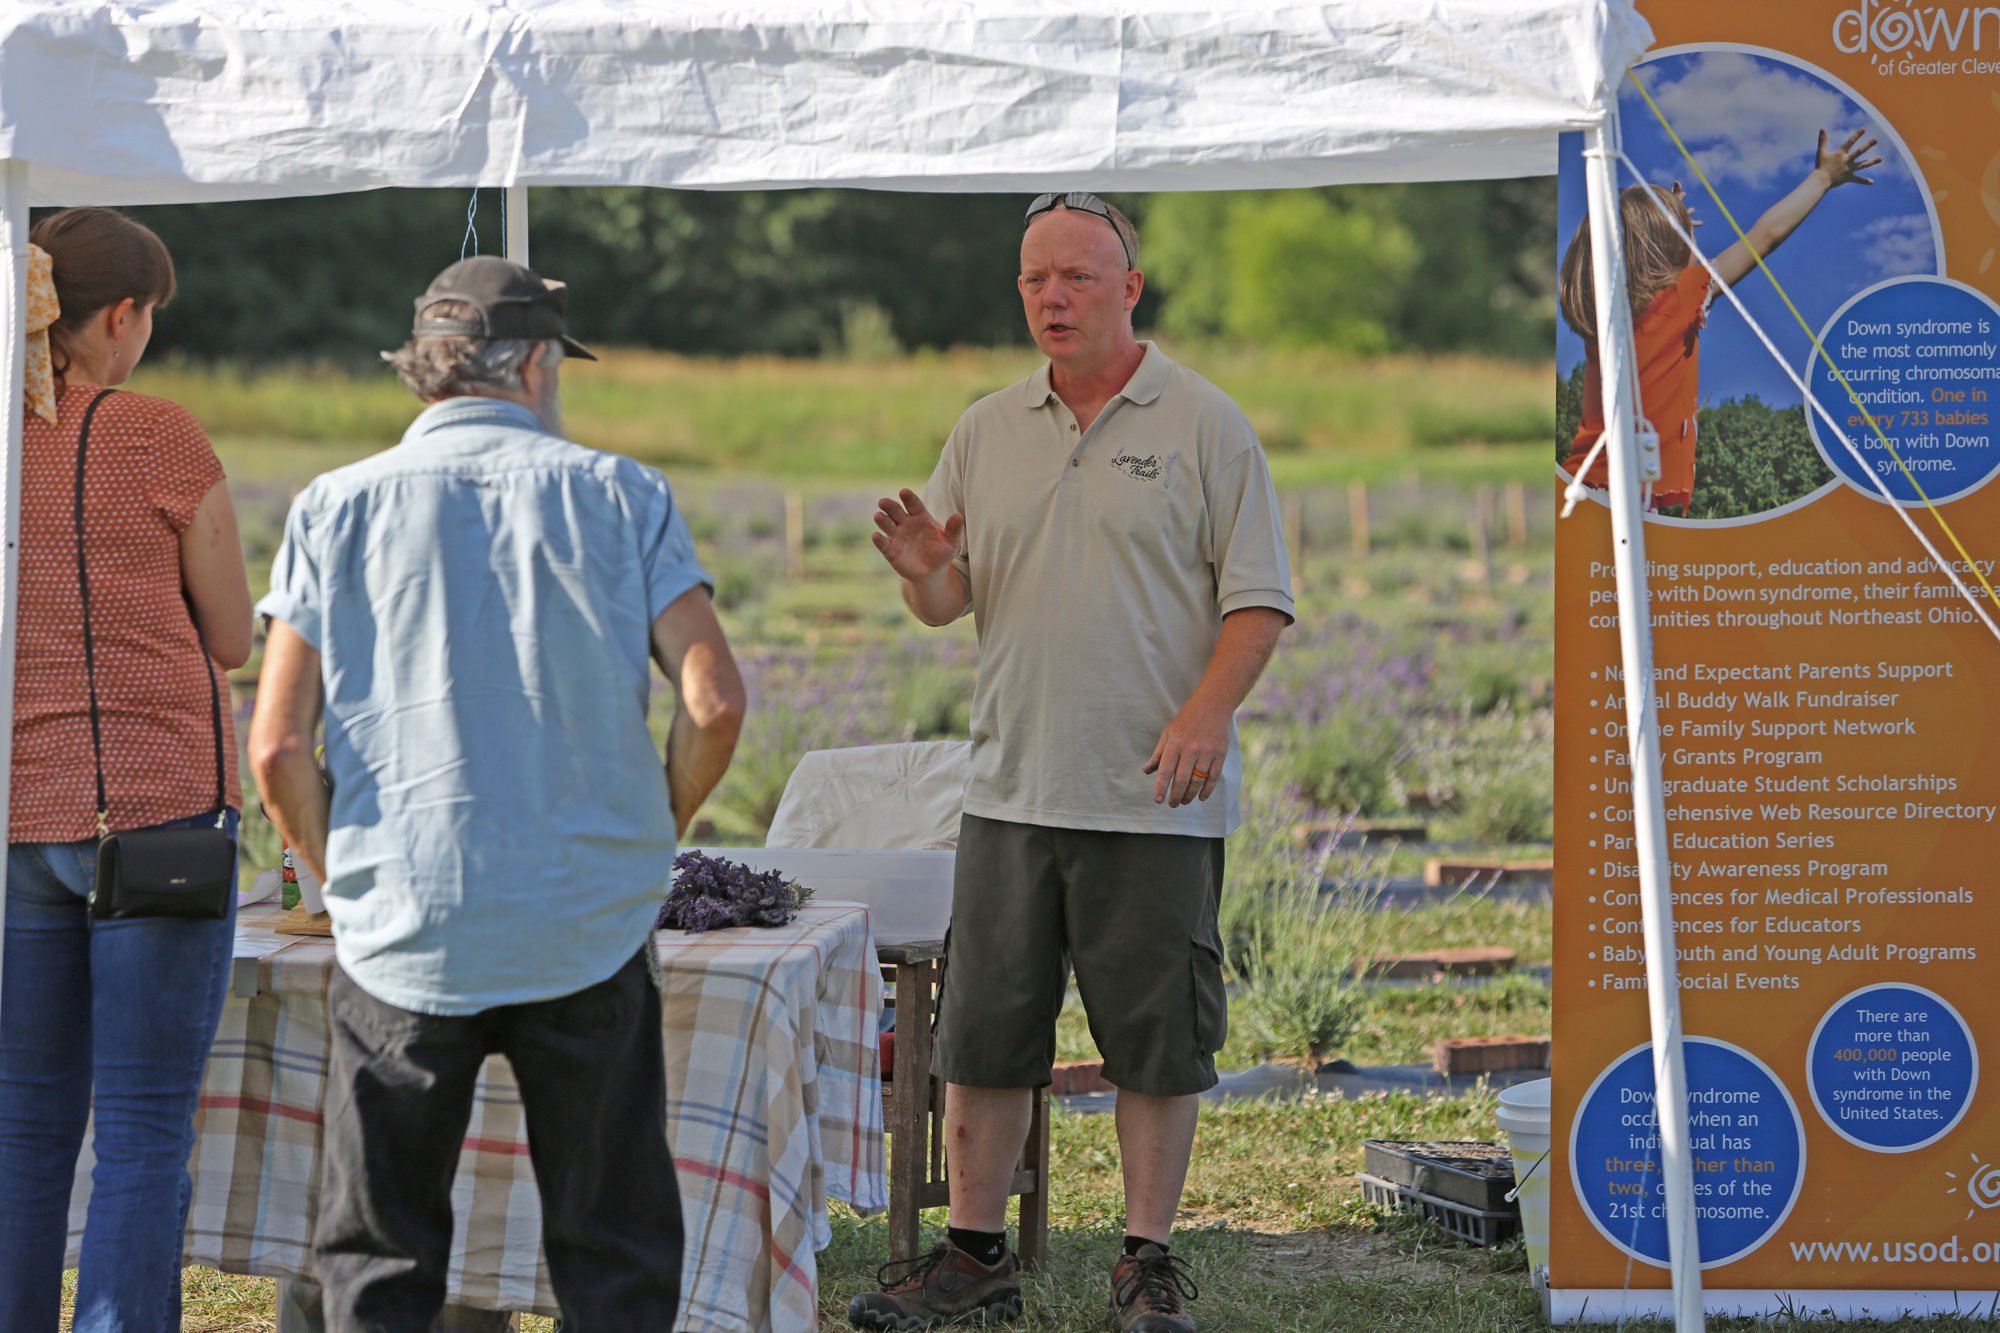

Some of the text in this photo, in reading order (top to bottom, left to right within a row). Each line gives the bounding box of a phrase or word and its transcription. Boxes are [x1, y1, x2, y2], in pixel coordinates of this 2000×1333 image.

[1832, 0, 2000, 53] down
[1879, 60, 1894, 75] of
[1898, 60, 1957, 75] Greater
[1848, 319, 1990, 338] Down syndrome is
[1841, 341, 1996, 359] the most commonly
[1849, 388, 1986, 404] condition. One in
[1848, 410, 1988, 430] every 733 babies
[1905, 433, 1938, 448] with
[1946, 433, 1988, 447] Down
[1111, 455, 1157, 468] Lavender
[1877, 457, 1956, 475] syndrome.
[1130, 465, 1159, 479] Trails
[1684, 561, 1762, 580] support,
[1769, 559, 1862, 575] education
[1868, 558, 1901, 574] and
[1657, 585, 1698, 601] with
[1704, 585, 1755, 601] Down
[1760, 584, 1858, 604] syndrome,
[1864, 583, 1910, 599] their
[1589, 607, 1979, 630] counities throughout Northeast Ohio.
[1653, 664, 1688, 680] and
[1695, 664, 1792, 684] Expectant
[1799, 663, 1871, 679] Parents
[1878, 662, 1953, 682] Support
[1604, 691, 1899, 712] Anal Buddy Walk Fundraiser
[1682, 720, 1744, 740] Family
[1752, 720, 1826, 740] Support
[1834, 718, 1915, 735] Network
[1674, 749, 1736, 764] Grants
[1744, 749, 1822, 768] Program
[1604, 774, 1957, 797] Ungraduate Student Scholarships
[1603, 803, 1996, 823] Coehensive Web Resource Directory
[1674, 833, 1768, 849] Education
[1777, 832, 1834, 848] Series
[1603, 860, 1887, 882] Disaity Awareness Program
[1603, 887, 1973, 908] Conences for Medical Professionals
[1730, 917, 1758, 933] for
[1766, 917, 1861, 932] Educators
[1675, 945, 1716, 963] outh
[1723, 945, 1757, 961] and
[1764, 945, 1821, 964] Young
[1827, 944, 1879, 960] Adult
[1887, 944, 1976, 964] Programs
[1603, 973, 1647, 991] Fami
[1736, 973, 1799, 989] Events
[1857, 1010, 1927, 1022] There are
[1855, 1029, 1929, 1041] more than
[1834, 1048, 1951, 1064] 400,000 people
[1854, 1068, 1930, 1080] with Down
[1621, 1088, 1657, 1104] Dow
[1834, 1087, 1951, 1103] syndrome in the
[1738, 1115, 1758, 1126] an
[1841, 1107, 1943, 1119] United States.
[1629, 1134, 1750, 1149] indiual has
[1605, 1157, 1661, 1175] three,
[1734, 1157, 1774, 1172] than
[1608, 1181, 1649, 1198] two,
[1719, 1180, 1736, 1195] of
[1743, 1180, 1771, 1195] the
[1609, 1203, 1770, 1219] 21st chmosome.
